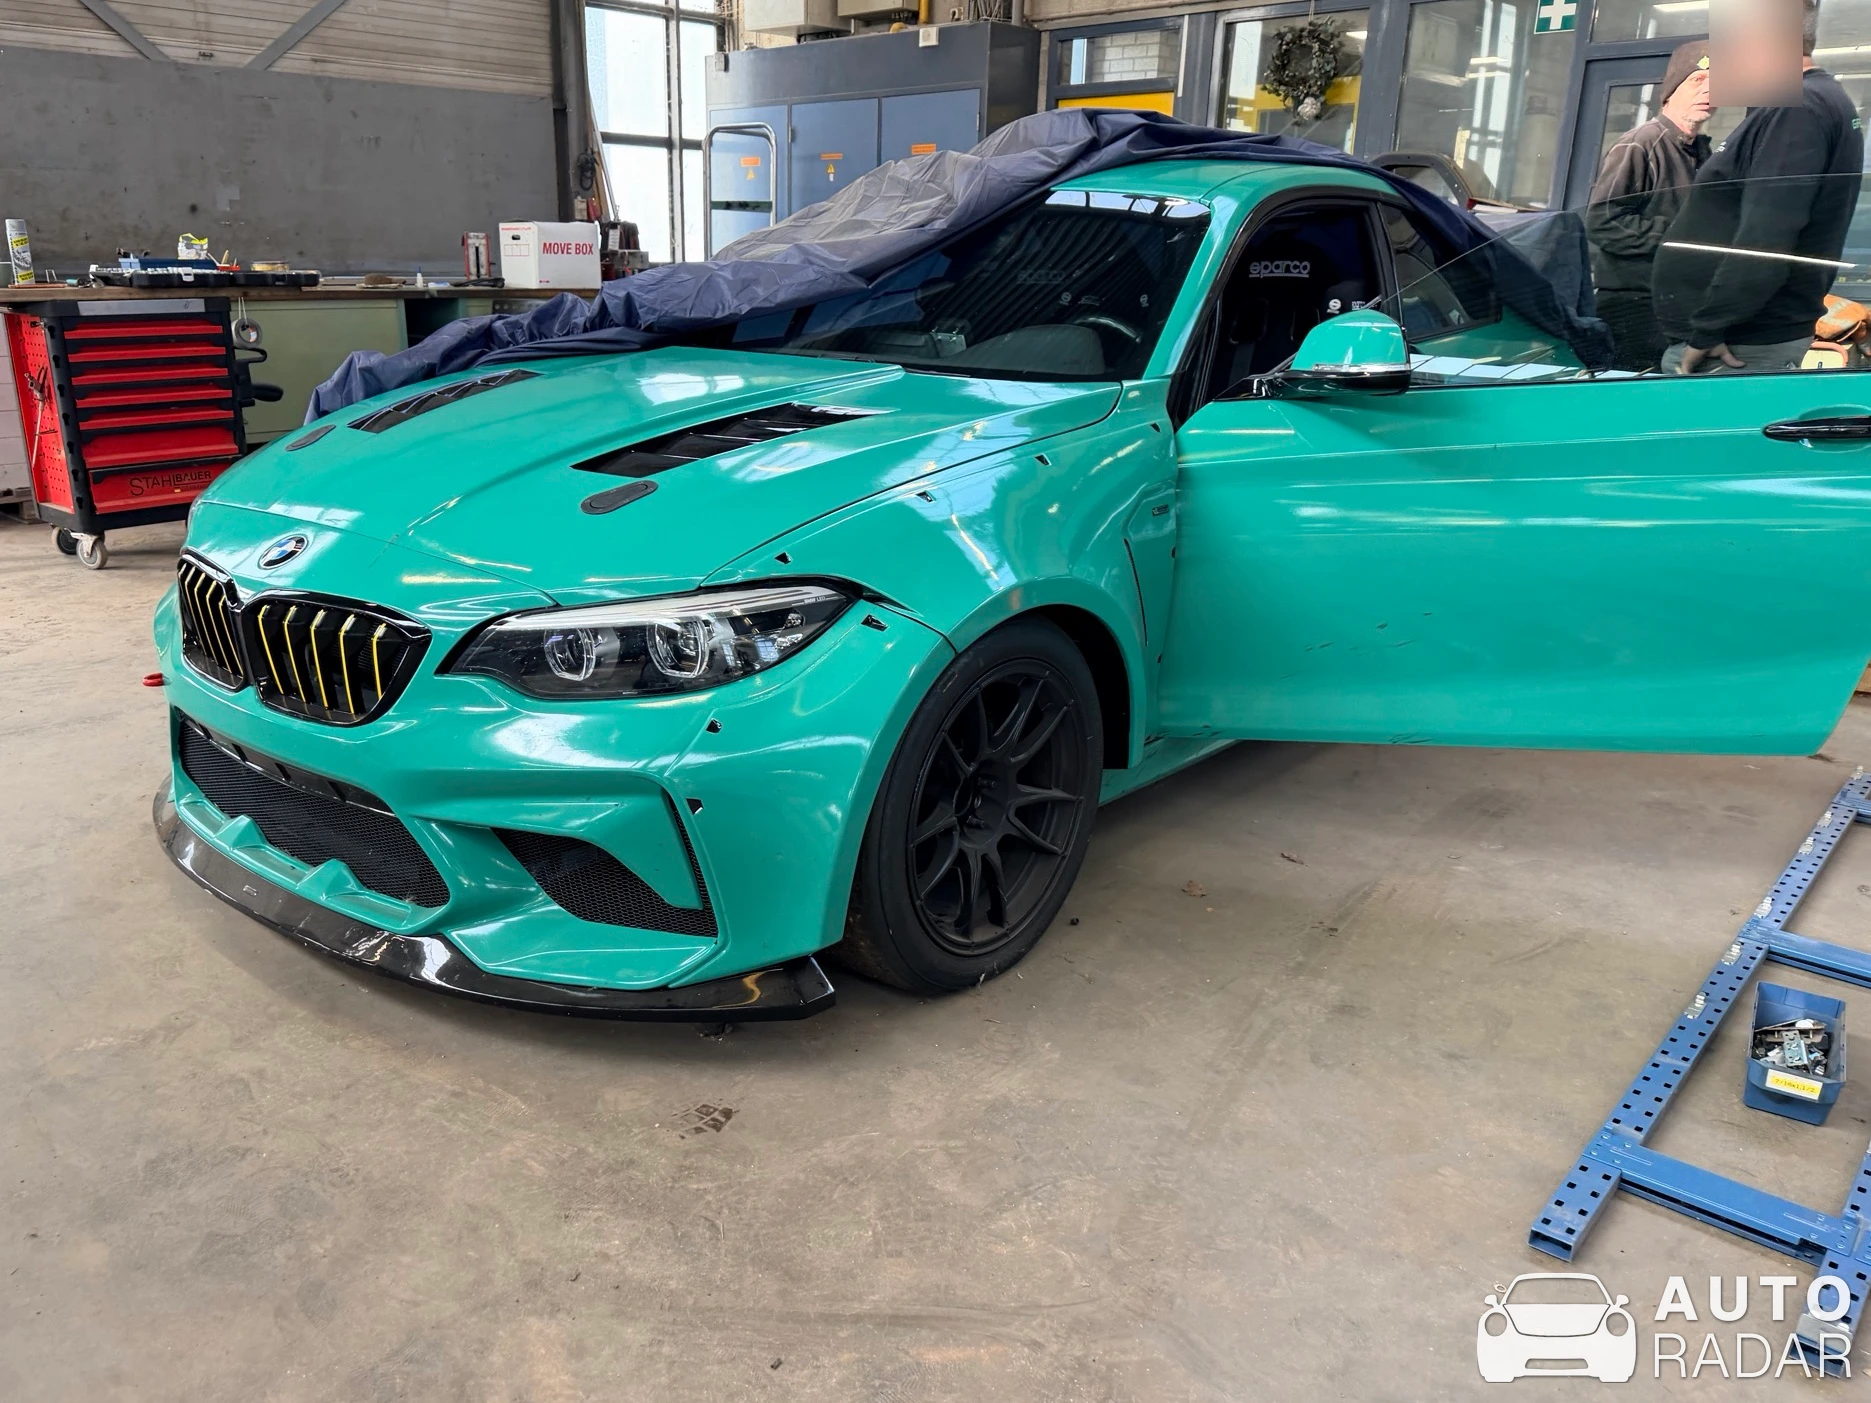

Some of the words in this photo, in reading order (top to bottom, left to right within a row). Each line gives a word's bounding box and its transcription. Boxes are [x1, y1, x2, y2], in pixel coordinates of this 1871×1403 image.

[542, 242, 572, 255] MOVE
[574, 243, 594, 255] BOX
[1249, 260, 1311, 278] sparco
